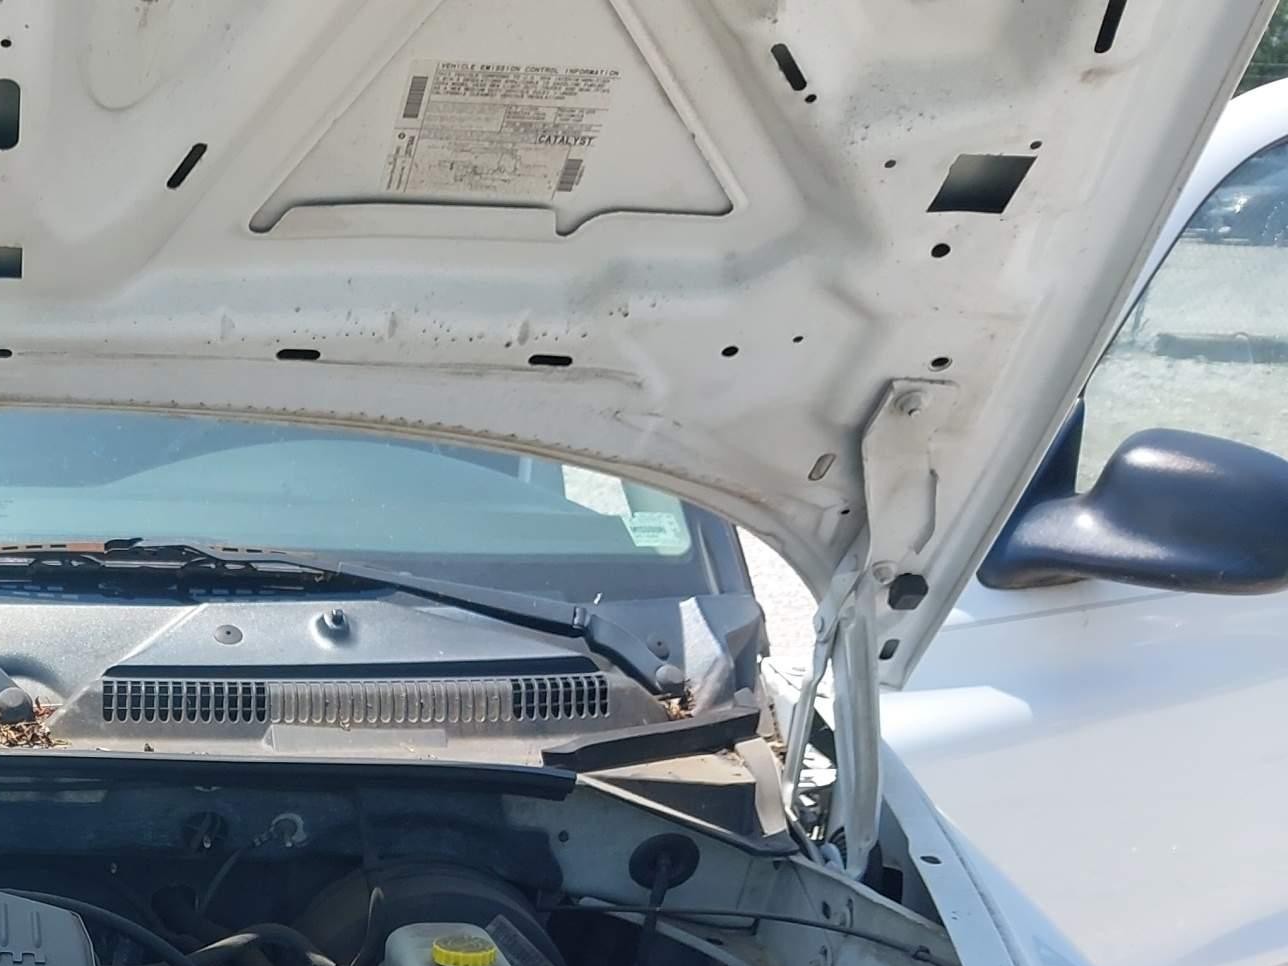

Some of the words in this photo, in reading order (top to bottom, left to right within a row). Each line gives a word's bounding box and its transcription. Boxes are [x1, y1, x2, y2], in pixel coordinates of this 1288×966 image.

[441, 63, 475, 71] VEHICLE
[480, 64, 521, 73] EMISSION
[525, 66, 559, 74] CONTROL
[564, 68, 620, 77] INFORMATION
[538, 135, 595, 146] CATALYST
